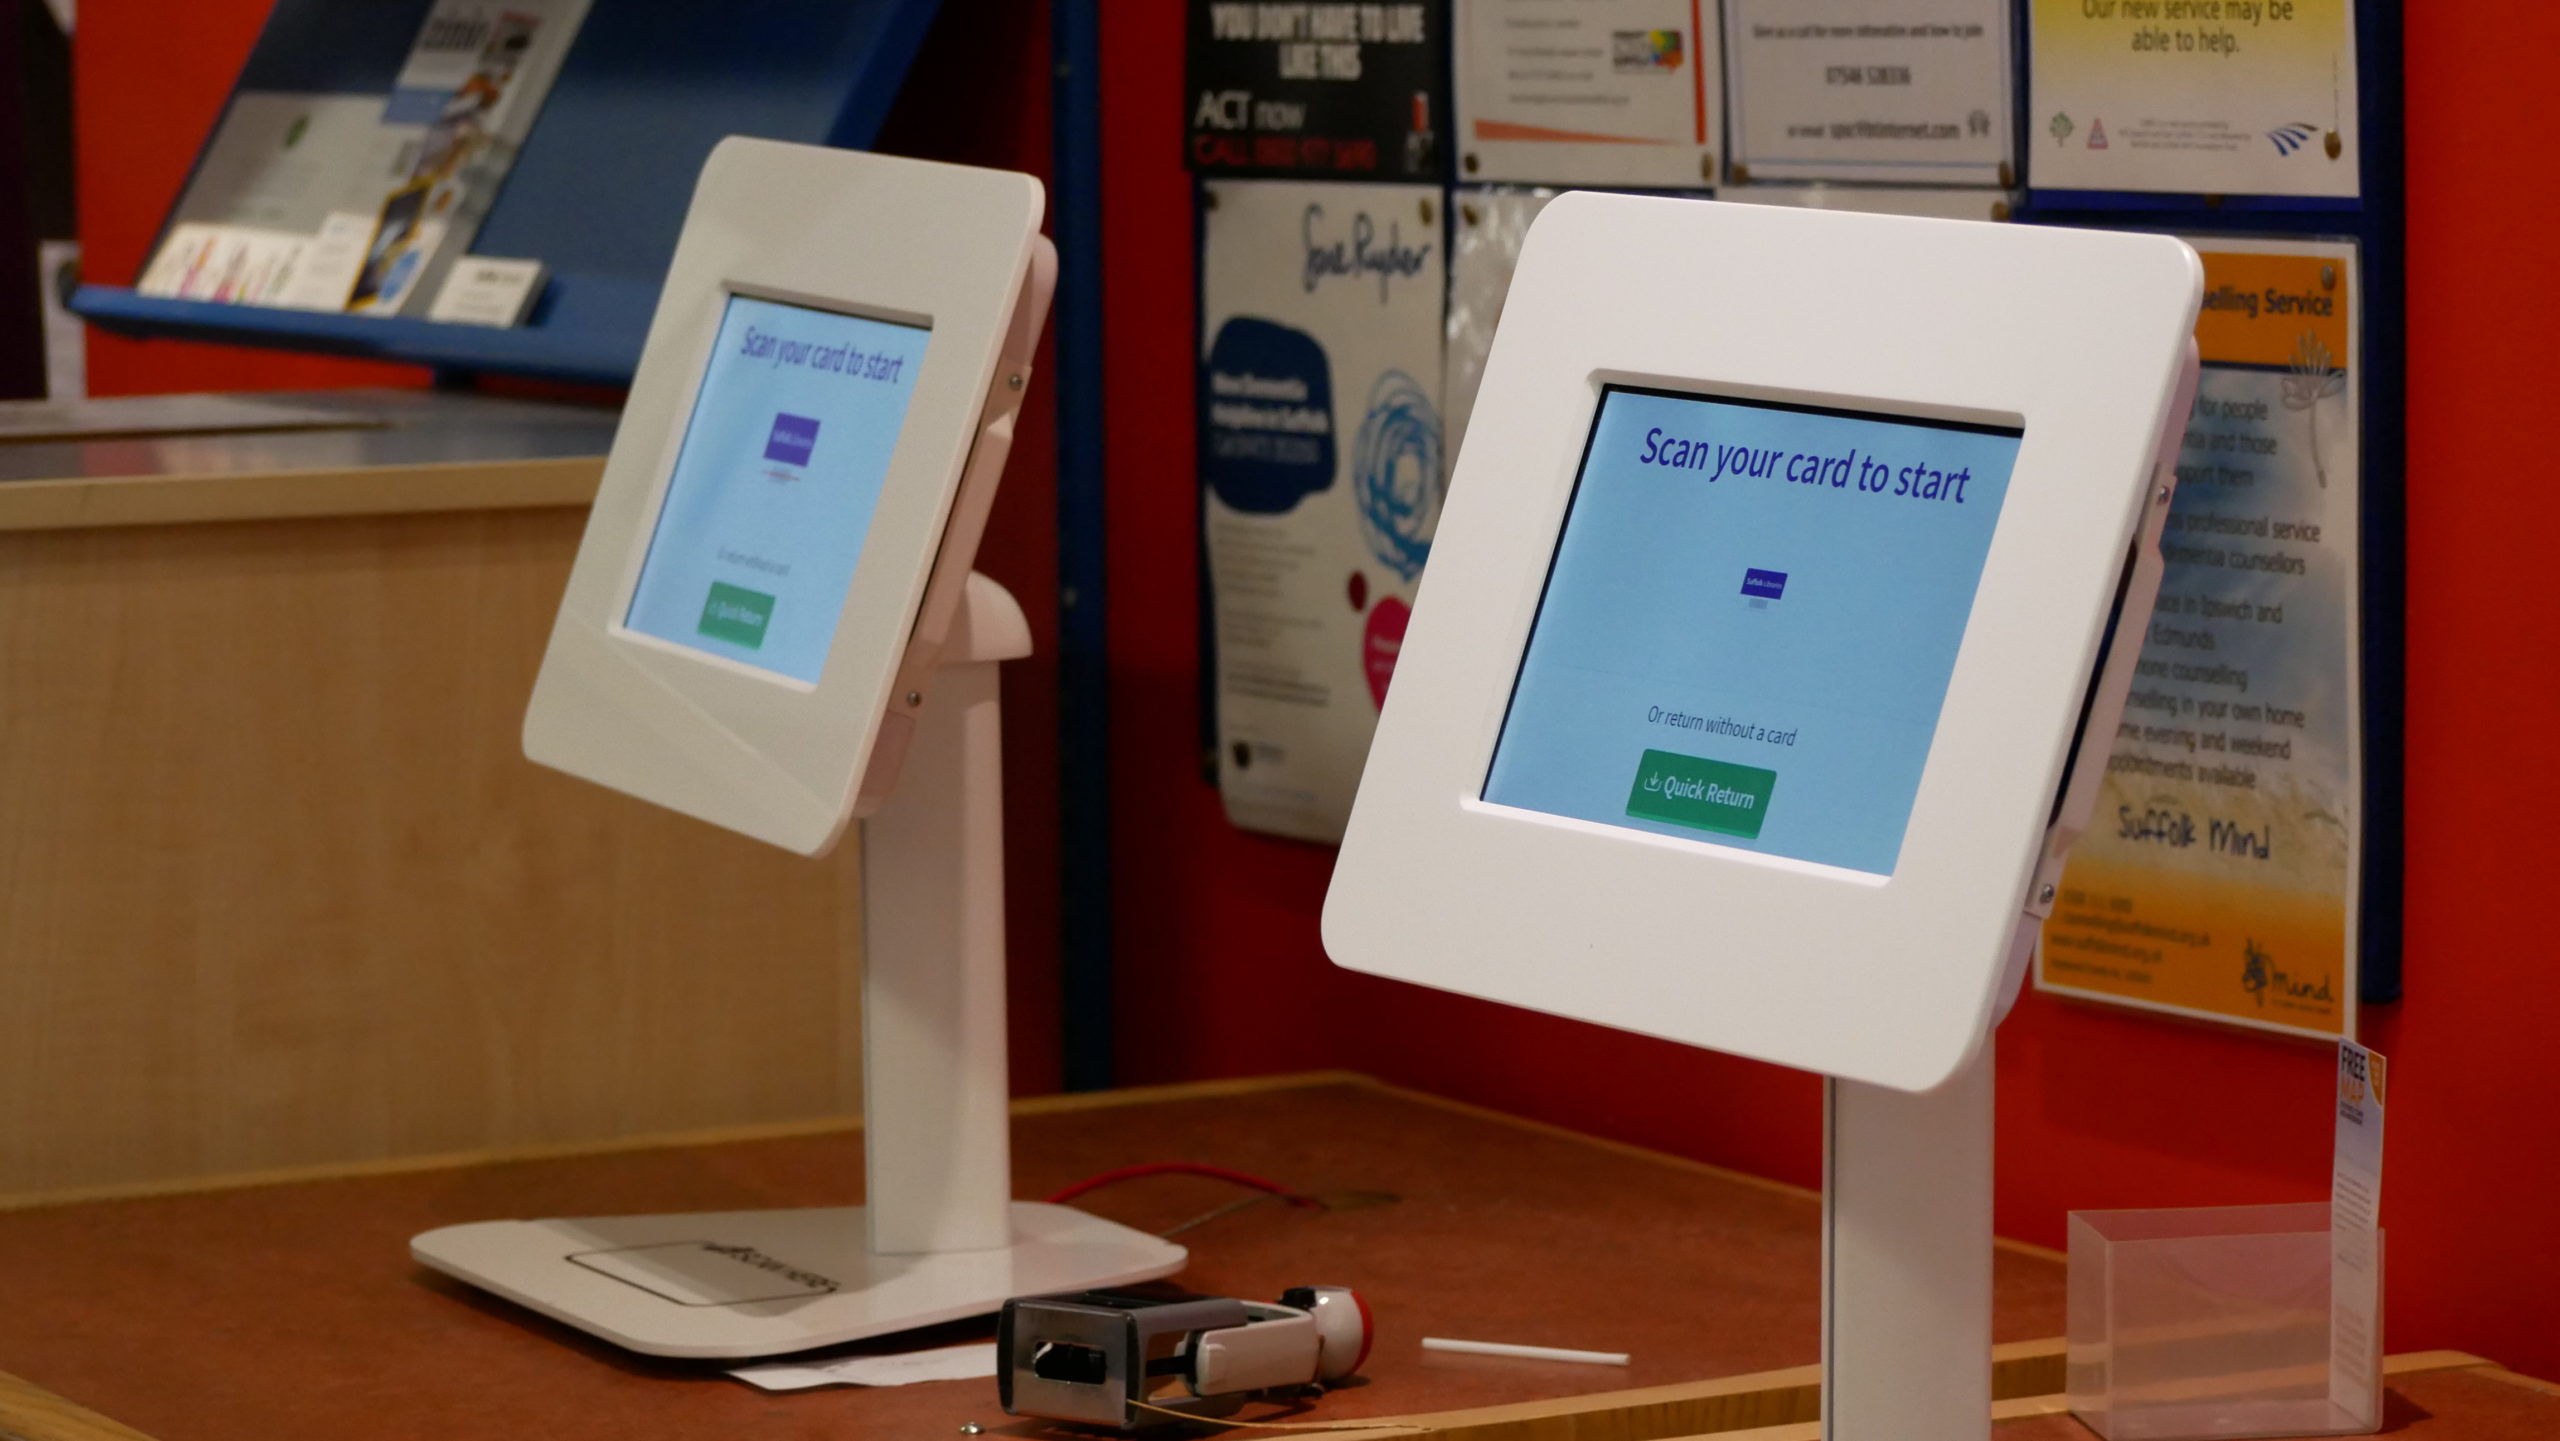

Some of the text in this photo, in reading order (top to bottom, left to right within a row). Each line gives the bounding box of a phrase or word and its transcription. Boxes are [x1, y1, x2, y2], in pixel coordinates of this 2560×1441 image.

[2082, 0, 2294, 27] Our new service may be
[2131, 26, 2240, 58] able to help.
[1195, 90, 1307, 130] ACT now
[2264, 288, 2334, 317] Service
[740, 325, 905, 385] Scan your card to start
[2222, 399, 2268, 421] people
[1640, 427, 1971, 504] Scan your card to start
[2272, 521, 2321, 543] service
[2257, 603, 2283, 624] and
[1647, 705, 1799, 747] Or return without a card
[2265, 702, 2306, 729] home
[2201, 730, 2227, 752] and
[1663, 774, 1756, 810] Quick Return
[2117, 804, 2272, 860] Suffolk Mind
[2341, 1045, 2366, 1082] FREE
